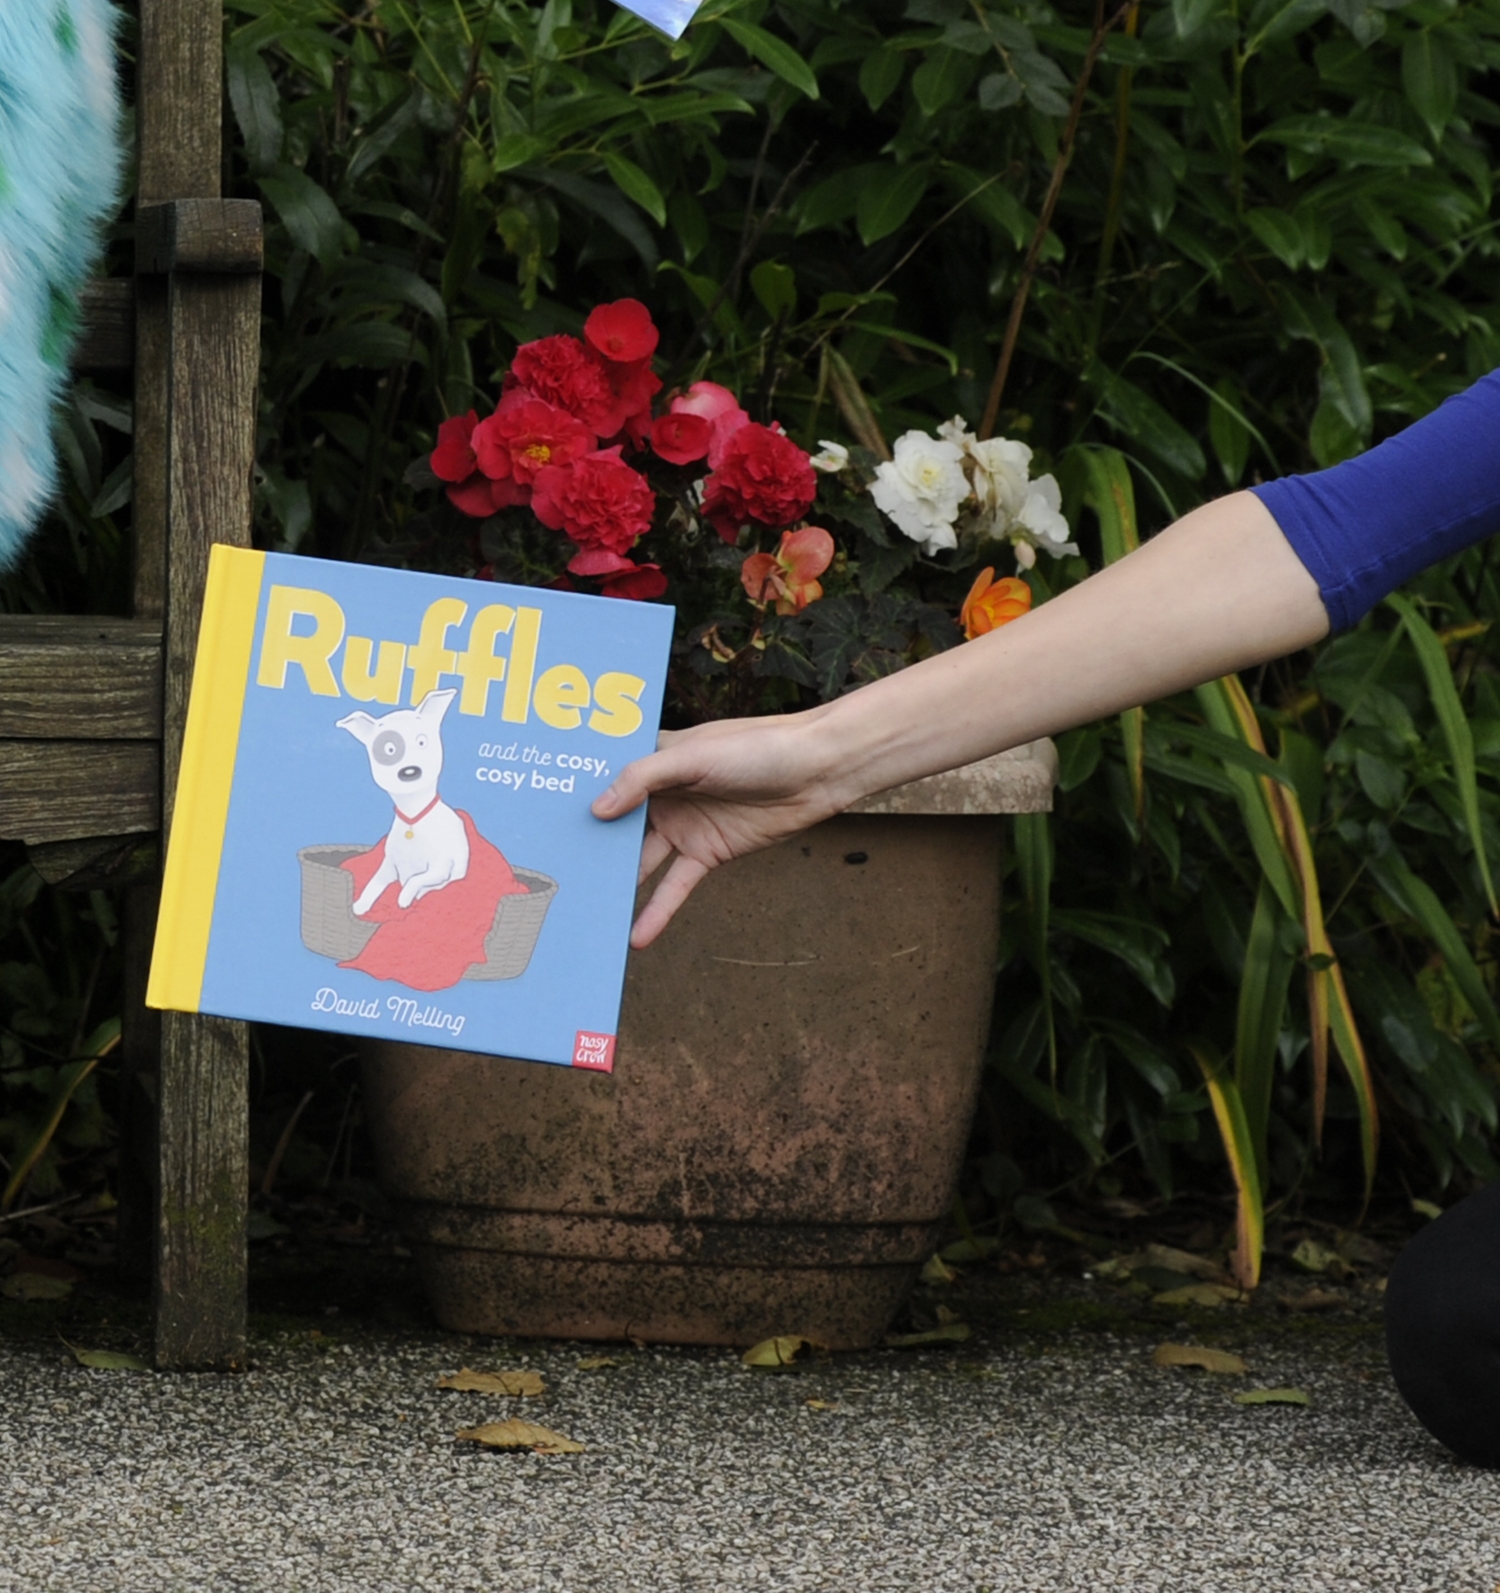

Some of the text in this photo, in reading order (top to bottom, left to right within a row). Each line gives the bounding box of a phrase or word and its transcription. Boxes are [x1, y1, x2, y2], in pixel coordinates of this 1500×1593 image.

[257, 583, 647, 739] Ruffles
[478, 742, 610, 778] and the cosy,
[475, 766, 575, 794] cosy bed
[311, 987, 465, 1036] David Melling
[576, 1047, 607, 1064] crow
[580, 1034, 609, 1055] nosy
